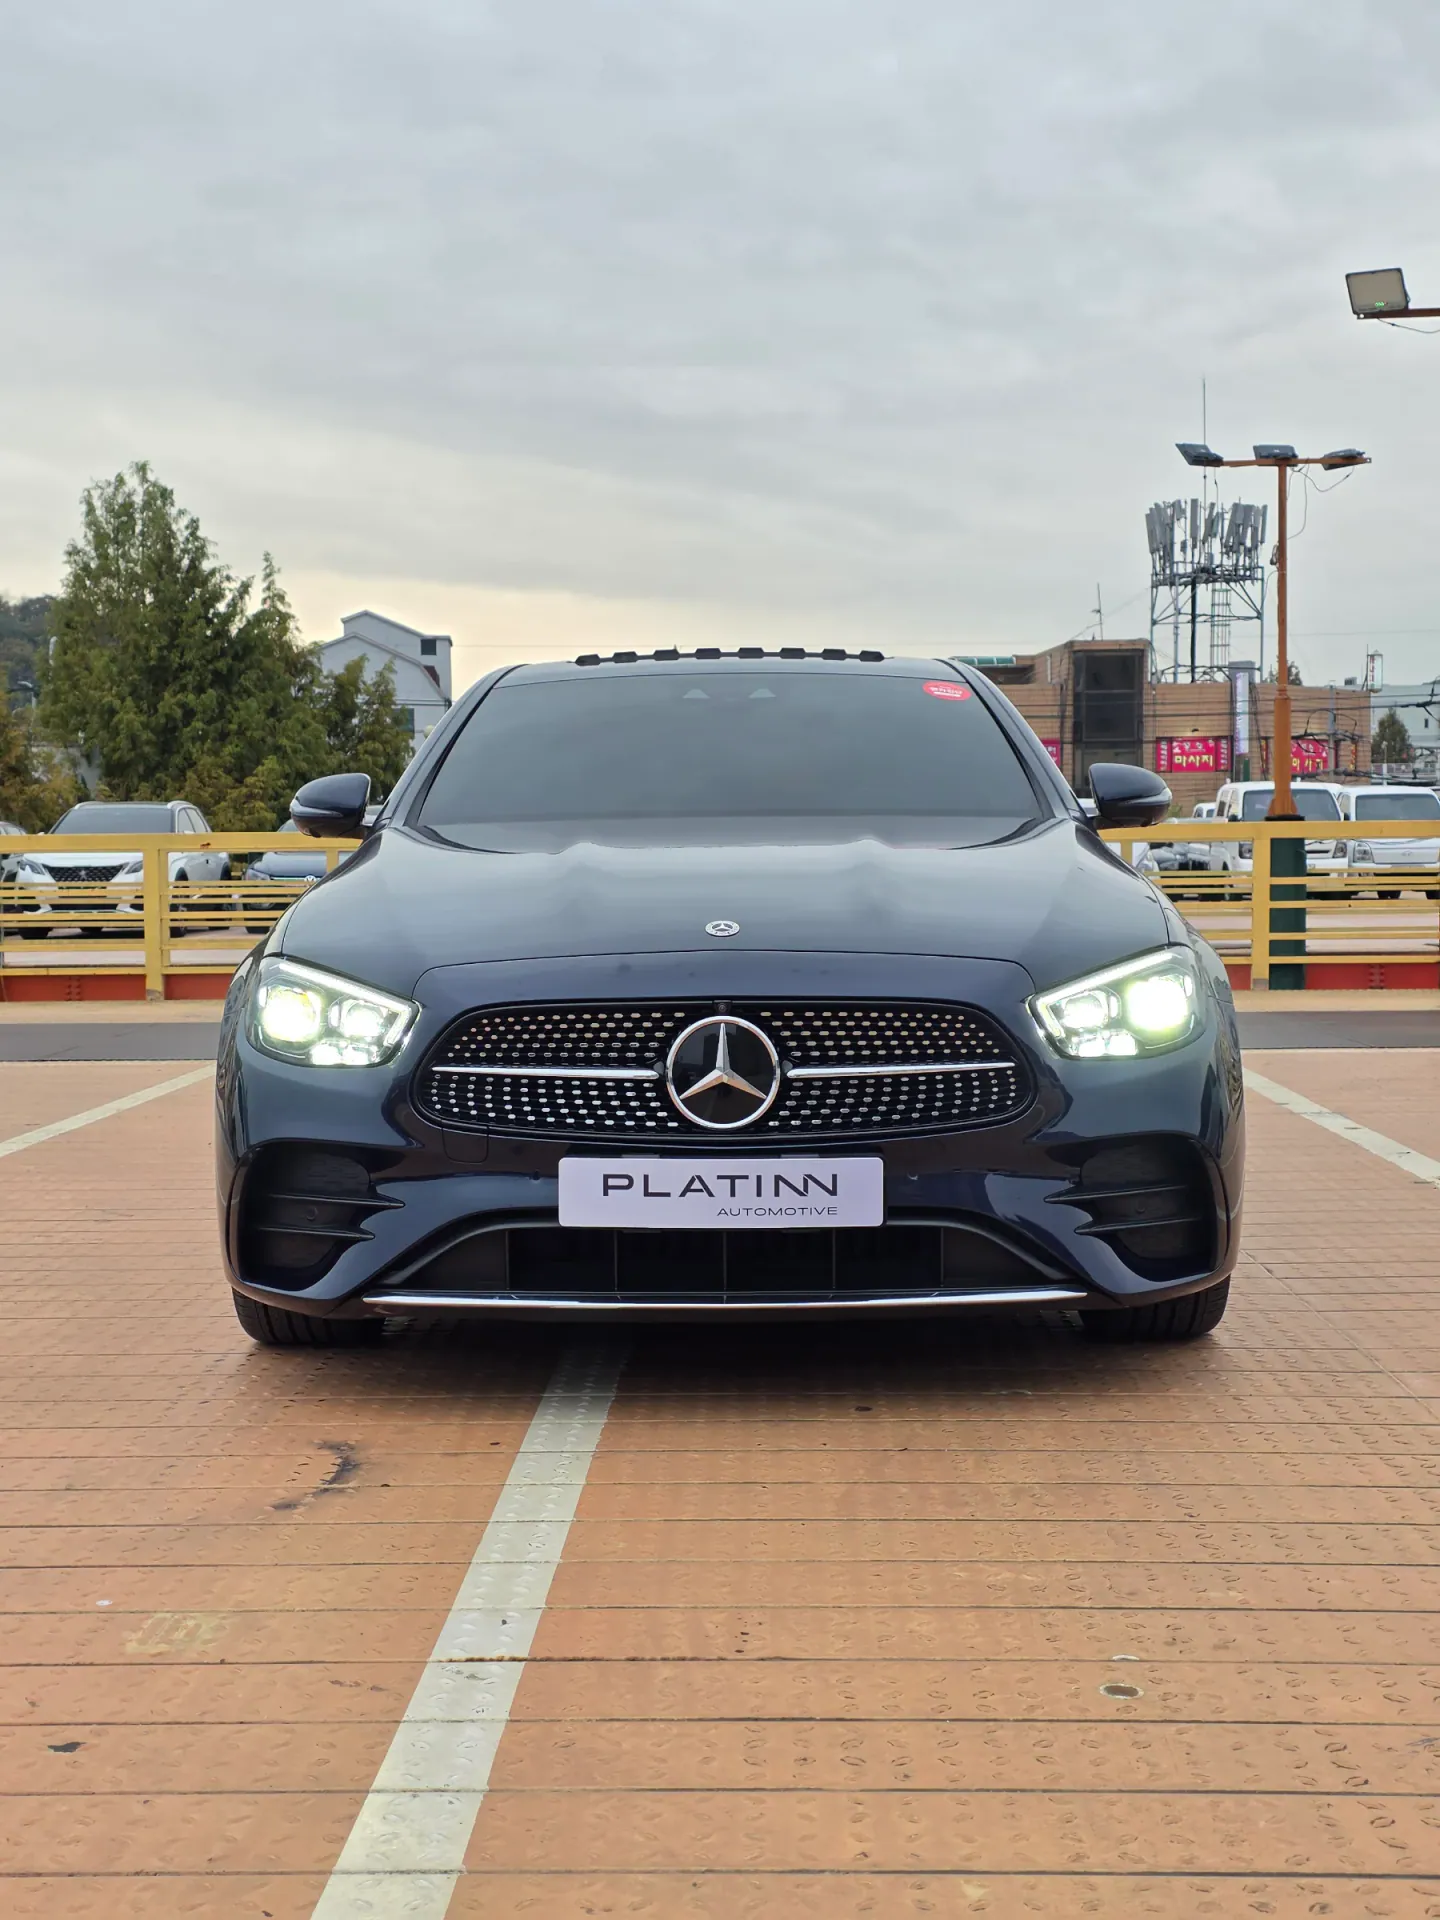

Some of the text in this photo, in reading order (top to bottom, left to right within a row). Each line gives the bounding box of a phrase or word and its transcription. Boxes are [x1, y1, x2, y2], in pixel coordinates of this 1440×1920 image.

[1174, 754, 1213, 768] 마사지
[602, 1173, 838, 1198] PLATINN
[716, 1206, 838, 1217] AUTOMOTIVE
